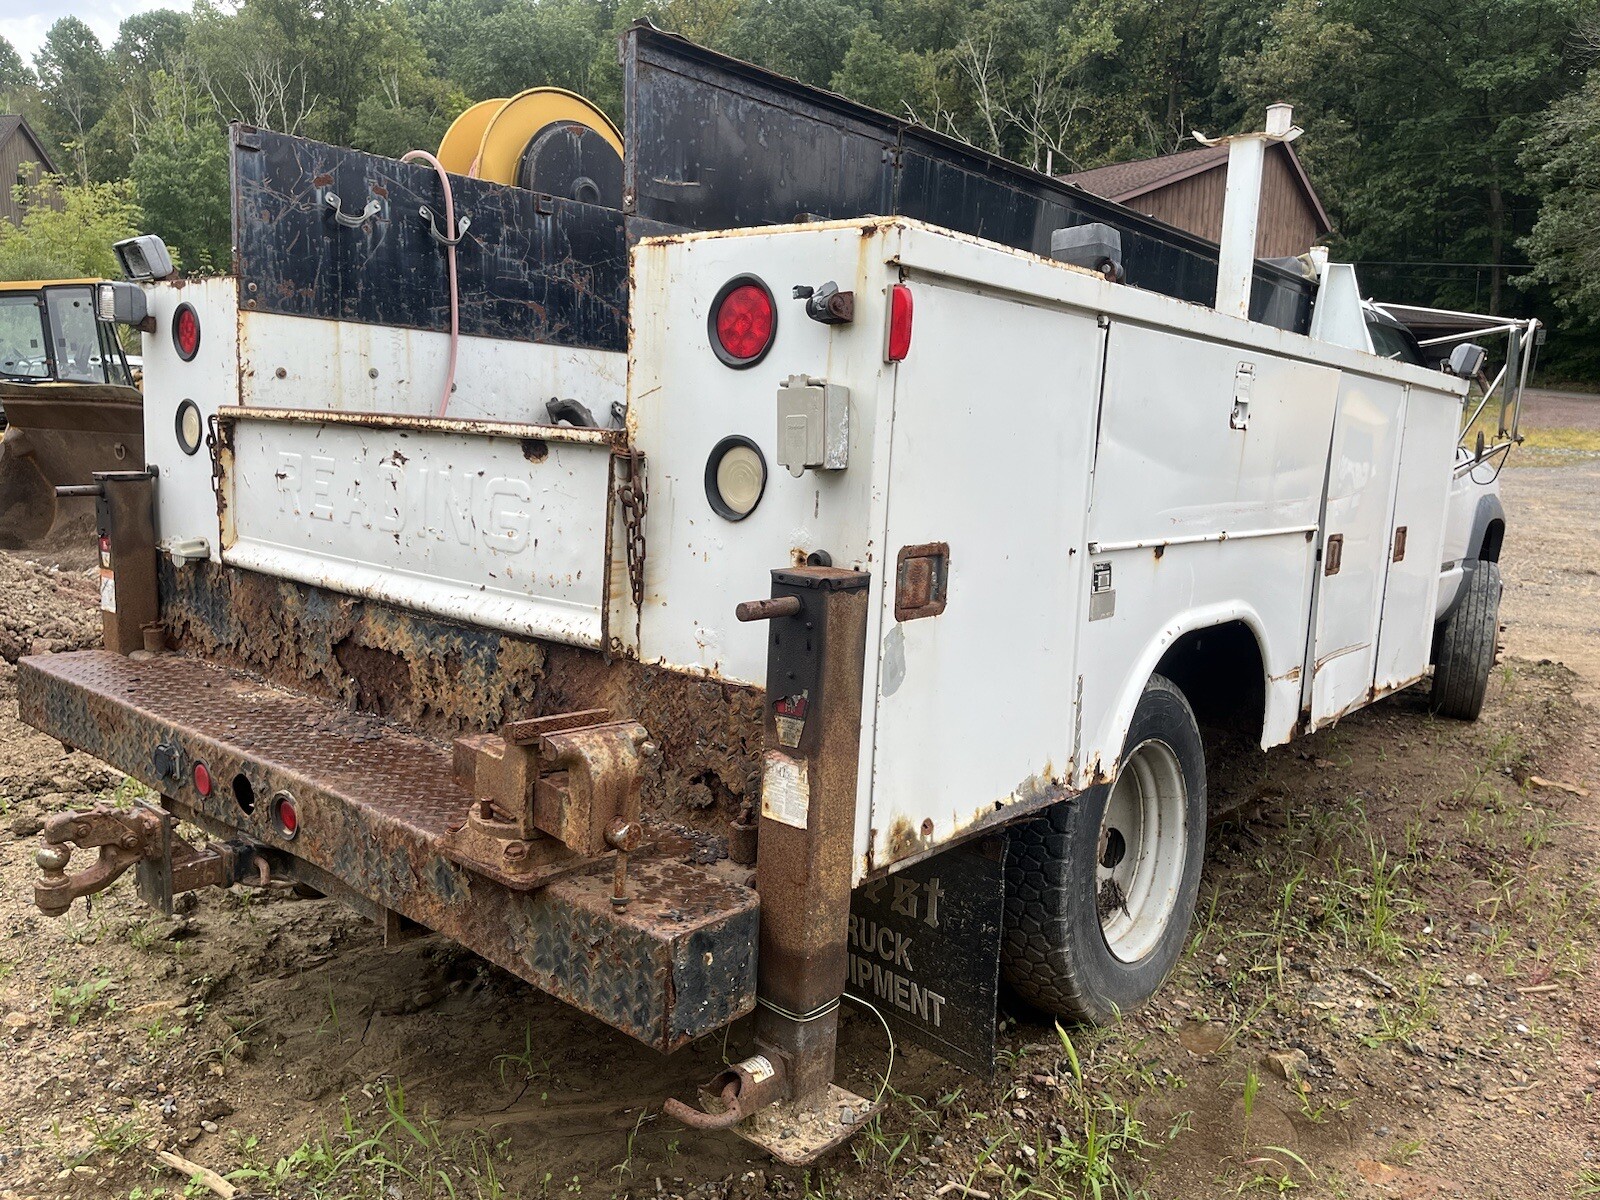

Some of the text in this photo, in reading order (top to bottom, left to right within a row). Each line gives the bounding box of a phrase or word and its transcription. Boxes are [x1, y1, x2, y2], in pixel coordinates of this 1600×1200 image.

[275, 451, 531, 555] READING
[848, 913, 914, 972] RUCK
[846, 952, 946, 1027] IPMENT
